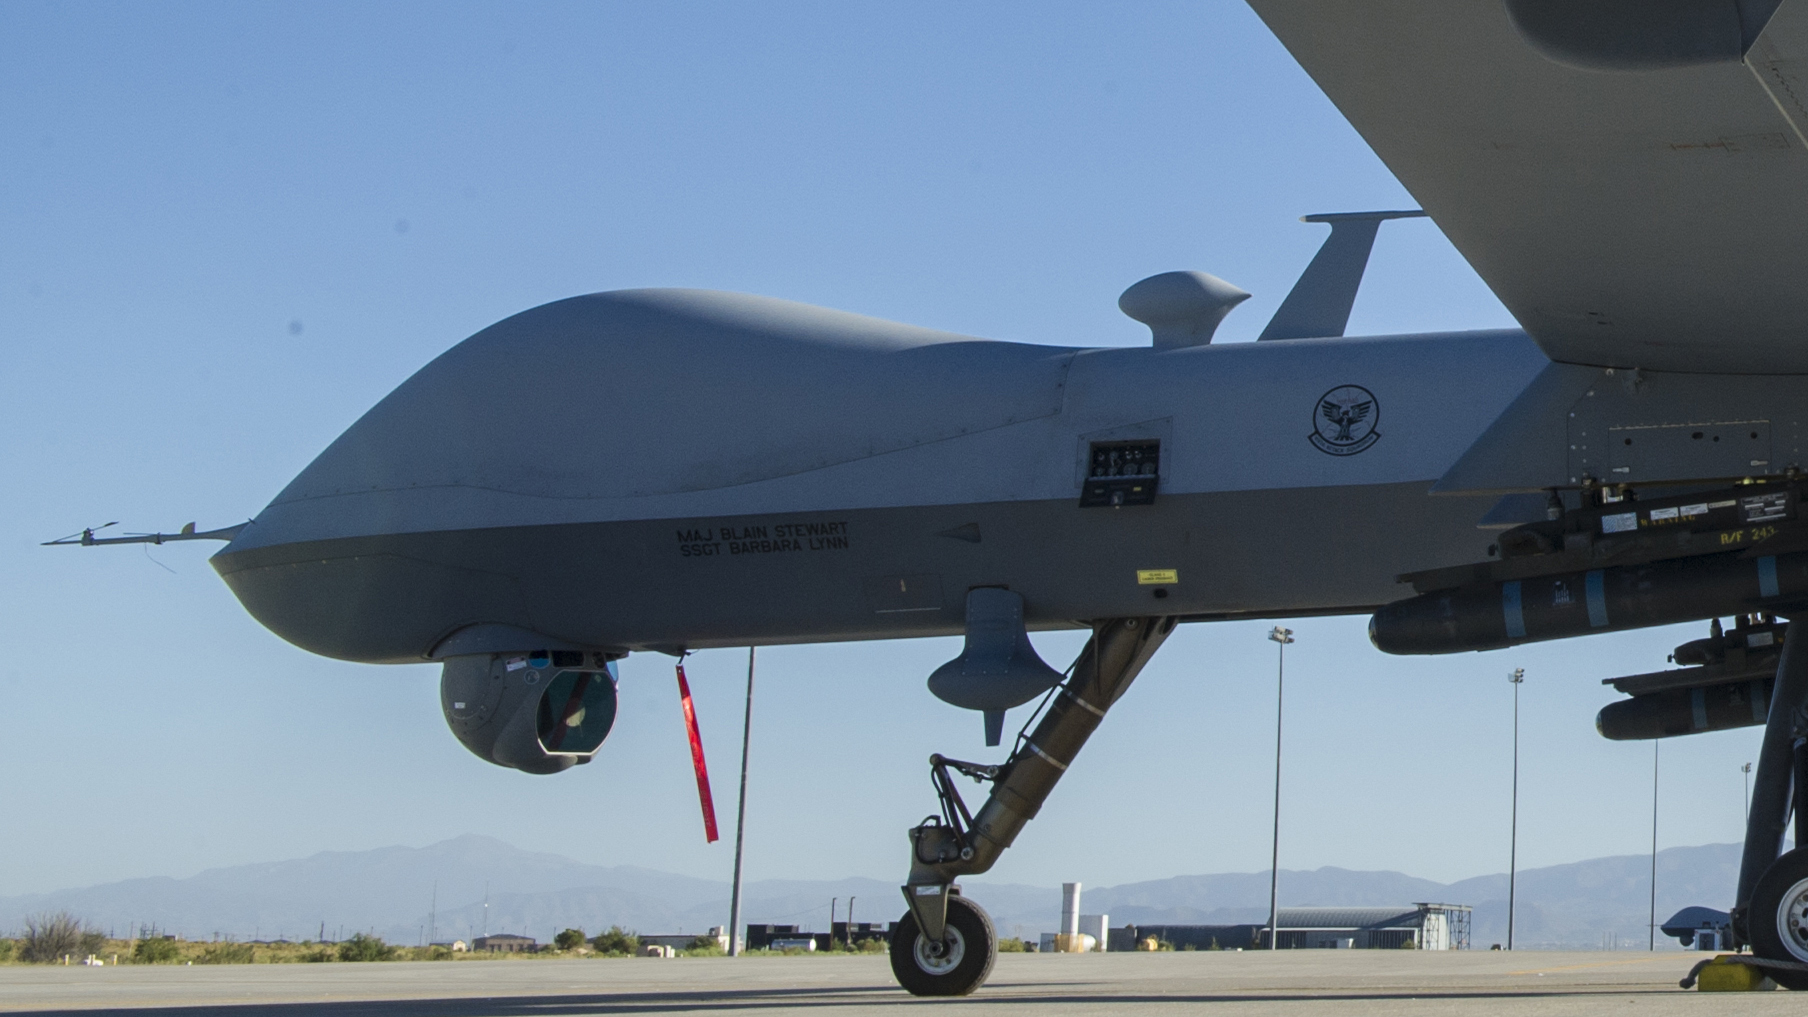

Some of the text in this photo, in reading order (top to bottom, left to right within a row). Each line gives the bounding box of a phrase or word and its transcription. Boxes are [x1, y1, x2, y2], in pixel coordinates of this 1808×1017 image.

[677, 521, 848, 543] MAJ BLAIN STEWART
[680, 536, 849, 557] SSGT BARBARA LYNN
